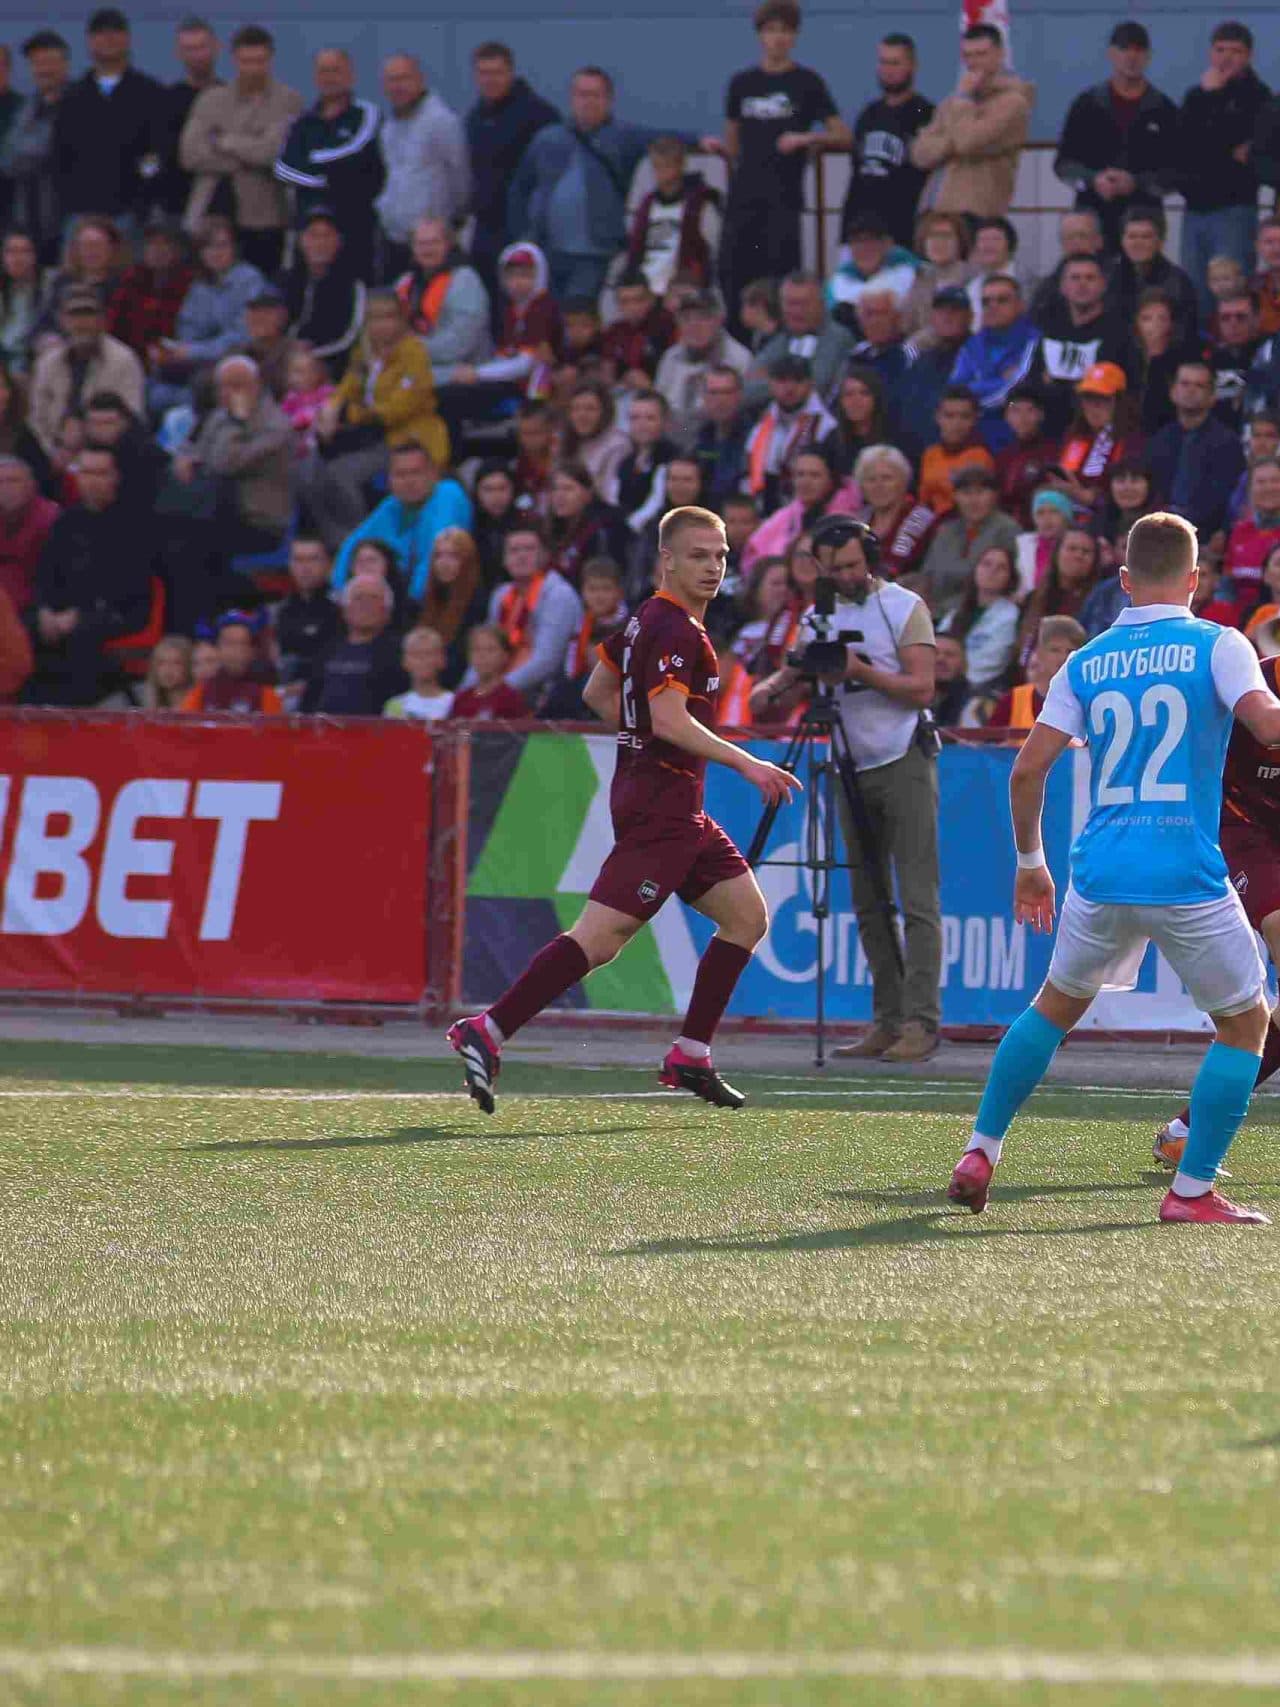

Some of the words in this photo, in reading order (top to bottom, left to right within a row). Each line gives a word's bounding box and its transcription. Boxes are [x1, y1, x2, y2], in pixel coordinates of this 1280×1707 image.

[1082, 642, 1197, 685] ГОЛУБЦОВ
[1090, 683, 1188, 806] 22
[835, 912, 1026, 991] ГРОМ
